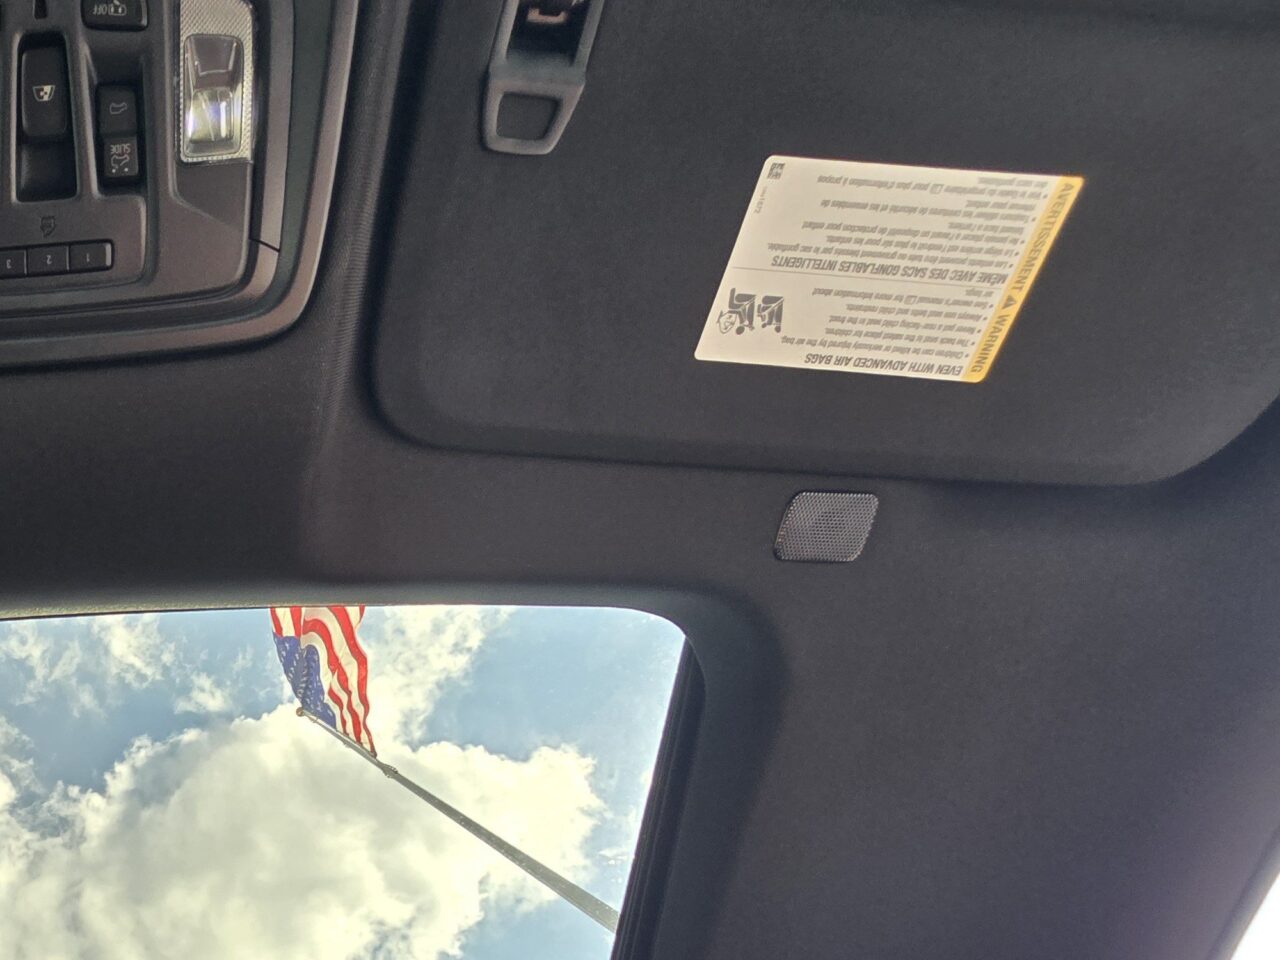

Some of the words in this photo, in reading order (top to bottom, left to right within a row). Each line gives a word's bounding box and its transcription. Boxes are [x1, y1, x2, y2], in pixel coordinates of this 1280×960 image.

[92, 3, 108, 15] OFF
[109, 143, 131, 154] SLIDE
[770, 255, 839, 269] INTELLIGENTS
[837, 260, 901, 274] GONFLABLES
[899, 265, 929, 276] SACS
[927, 267, 950, 278] DES
[948, 269, 978, 280] AVEC
[968, 313, 1011, 373] WARNING
[1008, 183, 1075, 291] AVERTISSEMENT
[974, 271, 1008, 284] MÊME
[803, 352, 834, 365] BAGS
[832, 355, 853, 366] AIR
[851, 356, 908, 371] ADVANCED
[906, 361, 936, 374] WITH
[933, 364, 963, 376] EVEN
